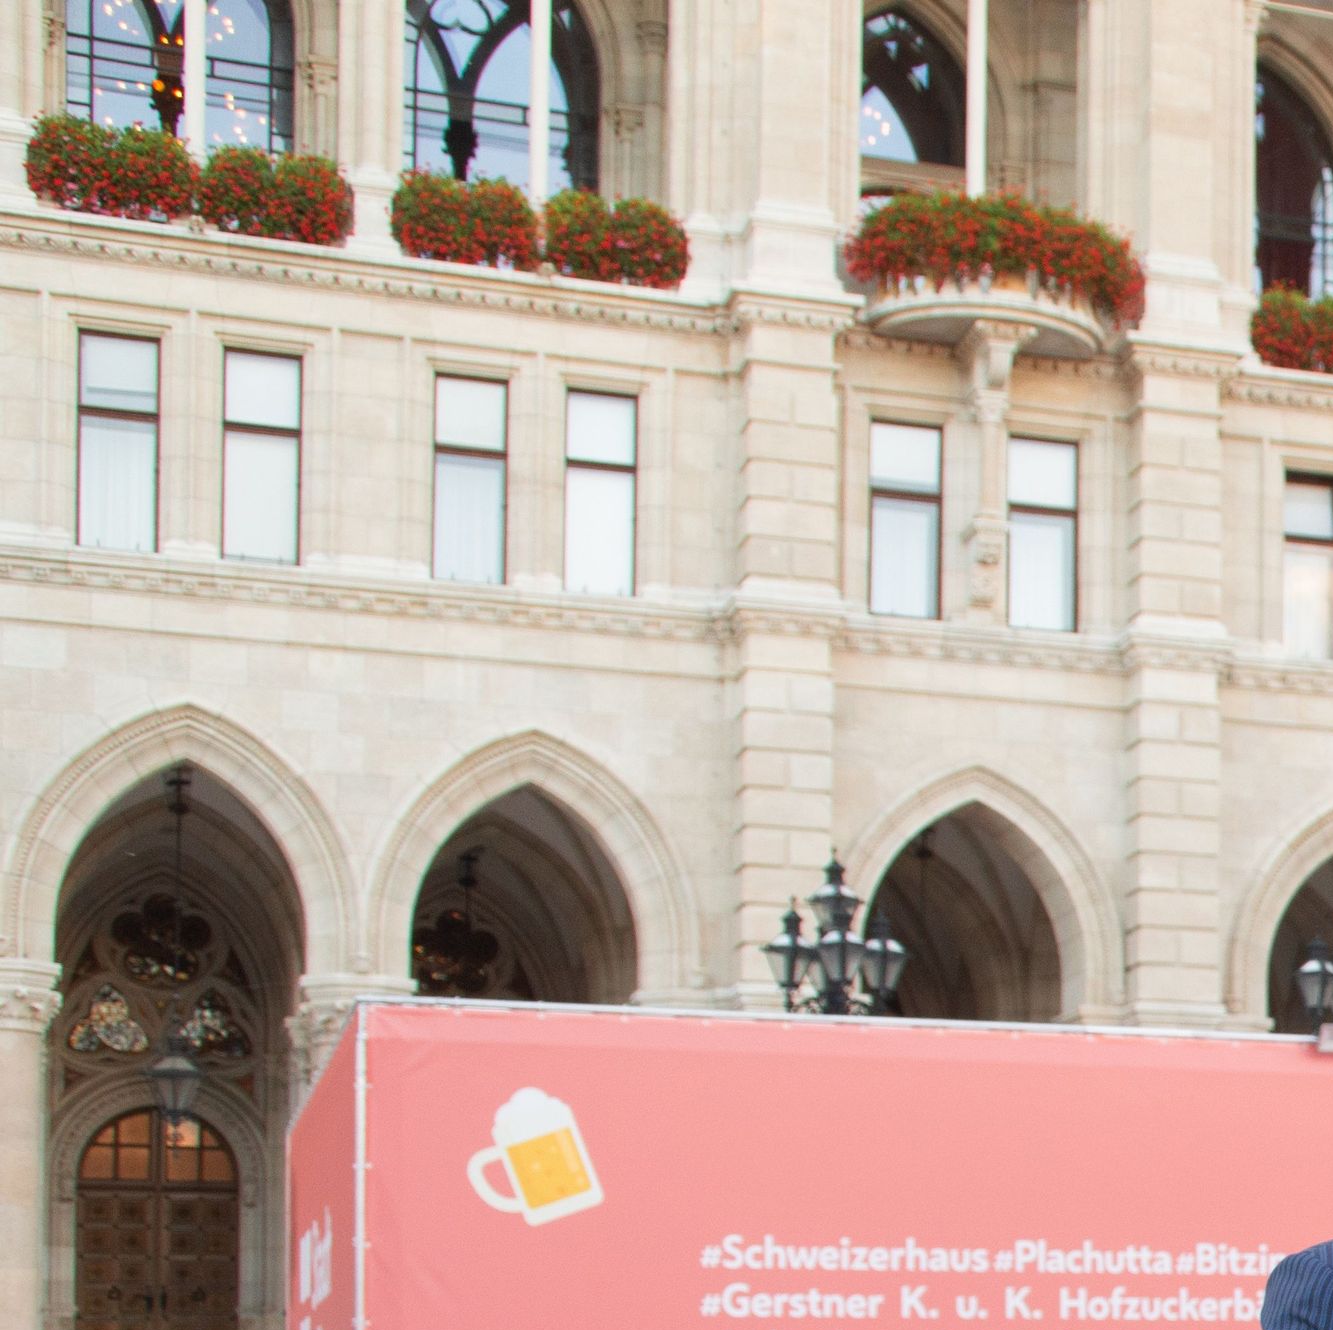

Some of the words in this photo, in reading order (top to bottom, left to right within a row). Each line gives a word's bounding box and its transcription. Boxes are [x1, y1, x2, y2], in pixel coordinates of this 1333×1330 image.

[700, 1233, 988, 1273] #Schweizerhaus
[994, 1239, 1172, 1275] #Plachutta
[700, 1283, 884, 1319] #Gerstner
[899, 1285, 940, 1320] K.
[954, 1296, 989, 1320] u.
[1004, 1286, 1043, 1320] K.
